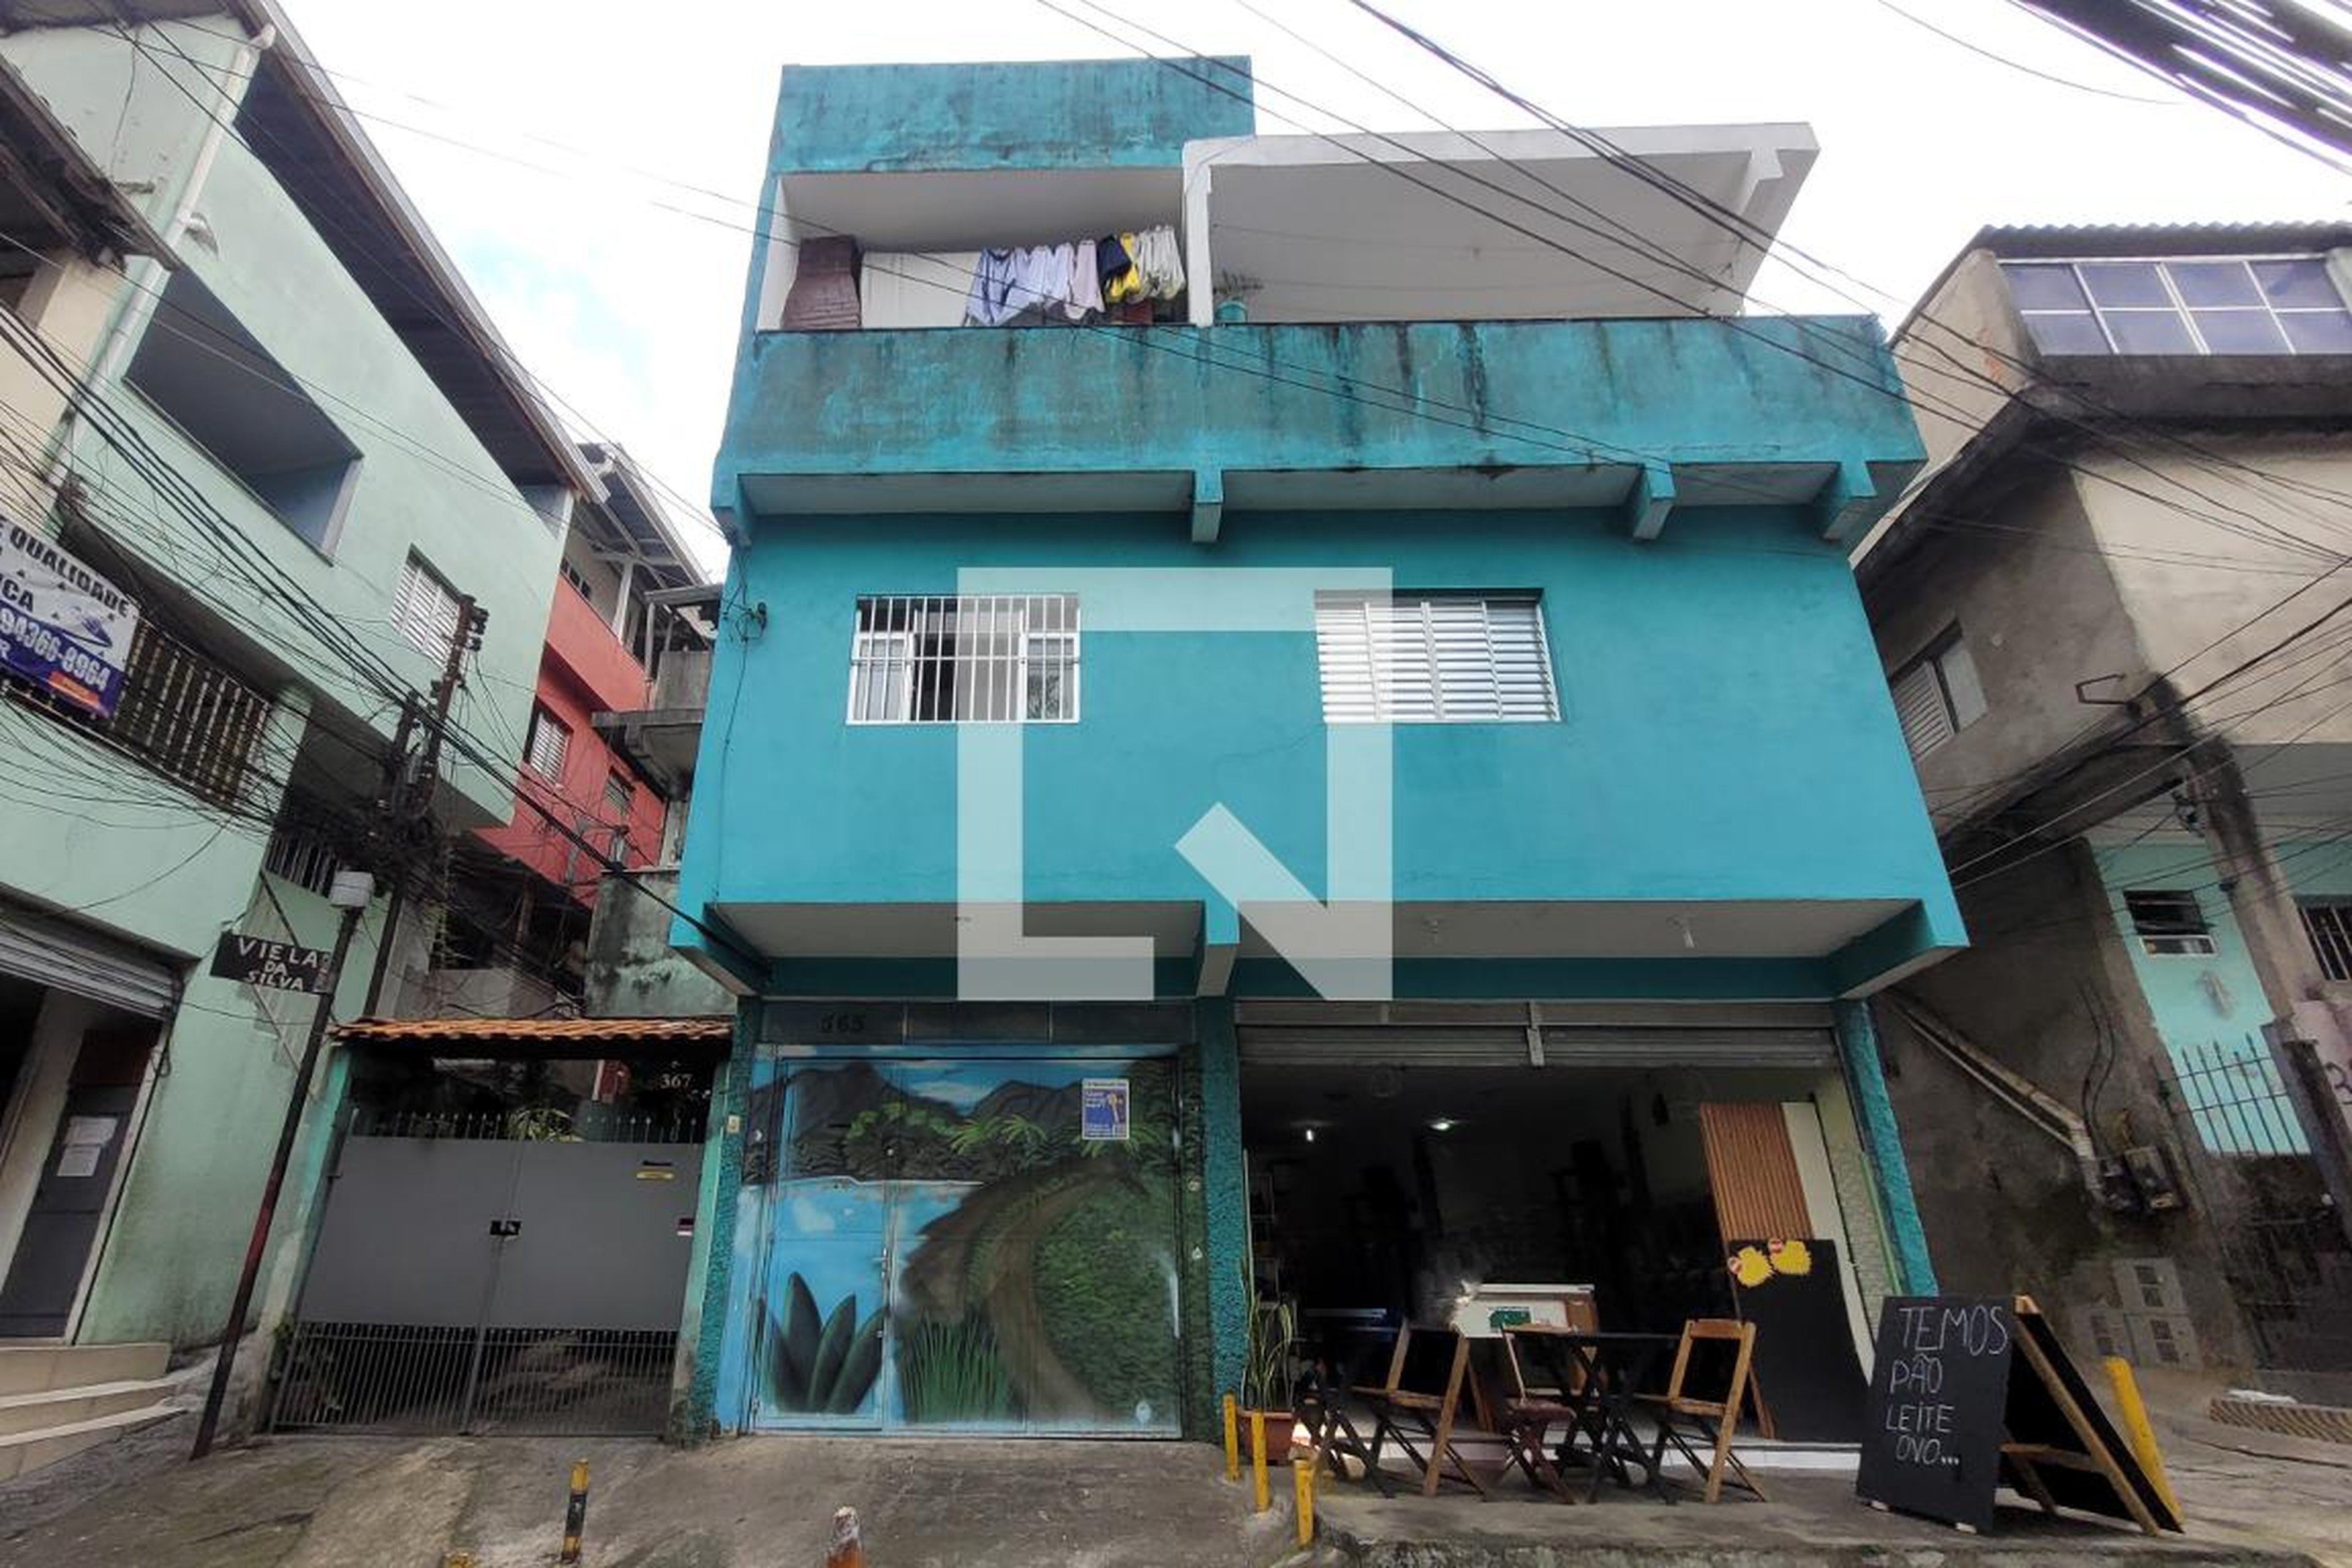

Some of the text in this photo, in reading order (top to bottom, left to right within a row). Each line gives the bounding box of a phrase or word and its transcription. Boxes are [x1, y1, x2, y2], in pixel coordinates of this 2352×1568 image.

[10, 526, 130, 619] QUALIDADE
[238, 937, 318, 968] VIELA
[264, 960, 288, 976] DA
[247, 970, 304, 991] SILVA
[661, 1073, 693, 1089] 367
[1898, 1305, 2008, 1356] TEMOS
[1885, 1401, 1954, 1433] LEITE
